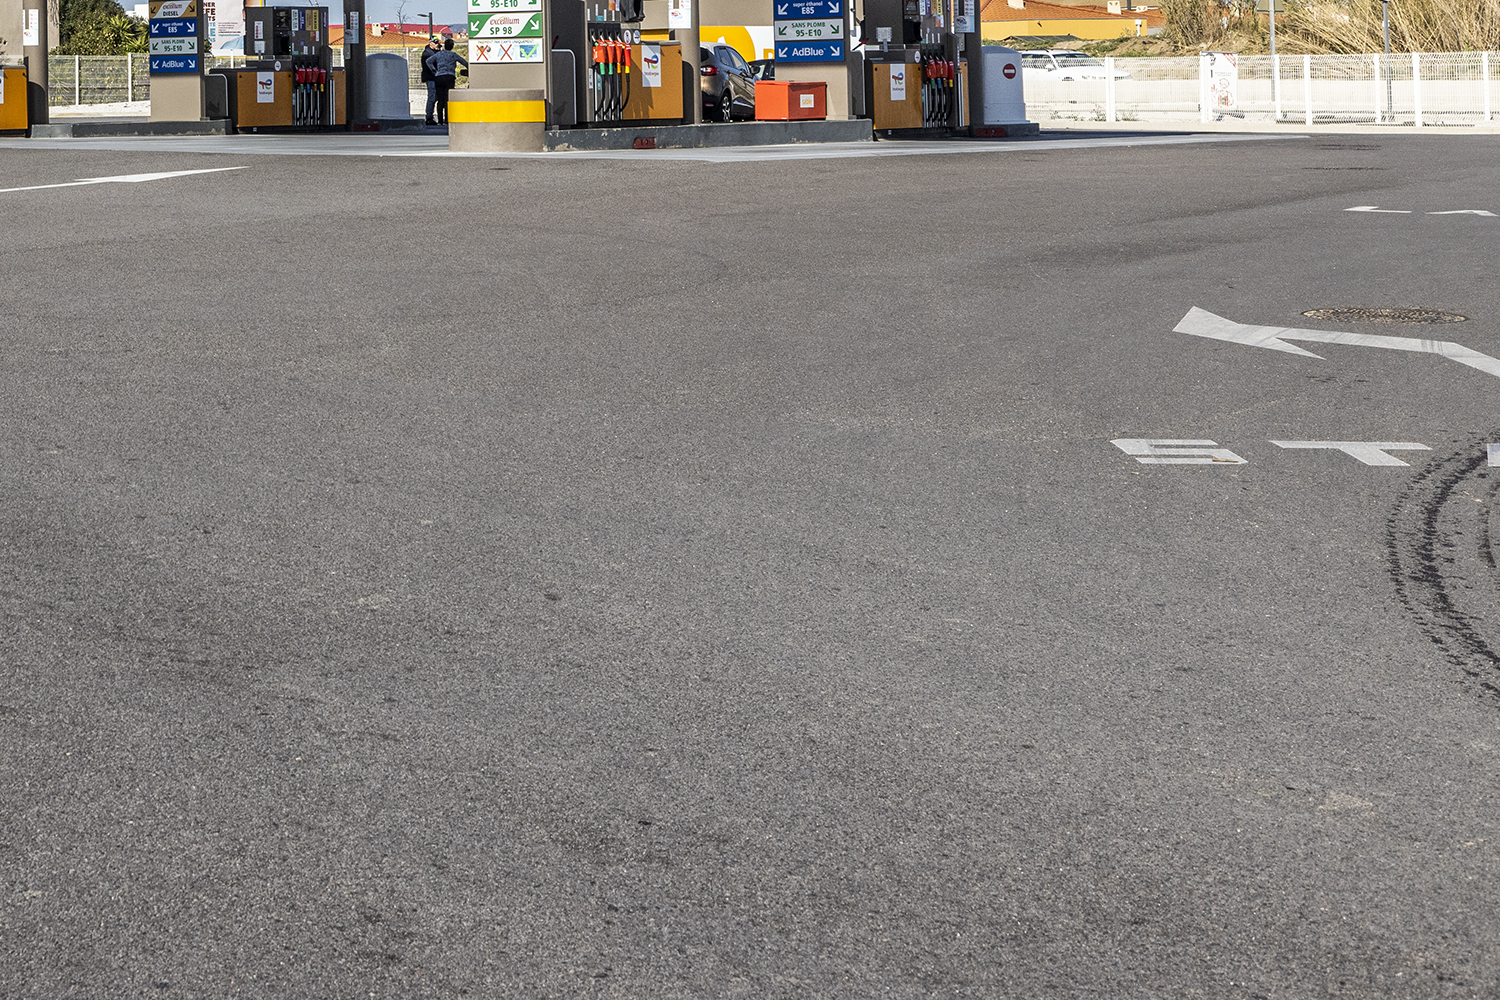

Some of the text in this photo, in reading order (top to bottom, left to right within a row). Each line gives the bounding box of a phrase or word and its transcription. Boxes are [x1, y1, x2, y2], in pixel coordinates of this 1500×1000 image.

[490, 0, 518, 8] 95-E10
[490, 16, 520, 25] excellium
[490, 26, 512, 35] SP 98
[796, 29, 822, 37] 95-E10
